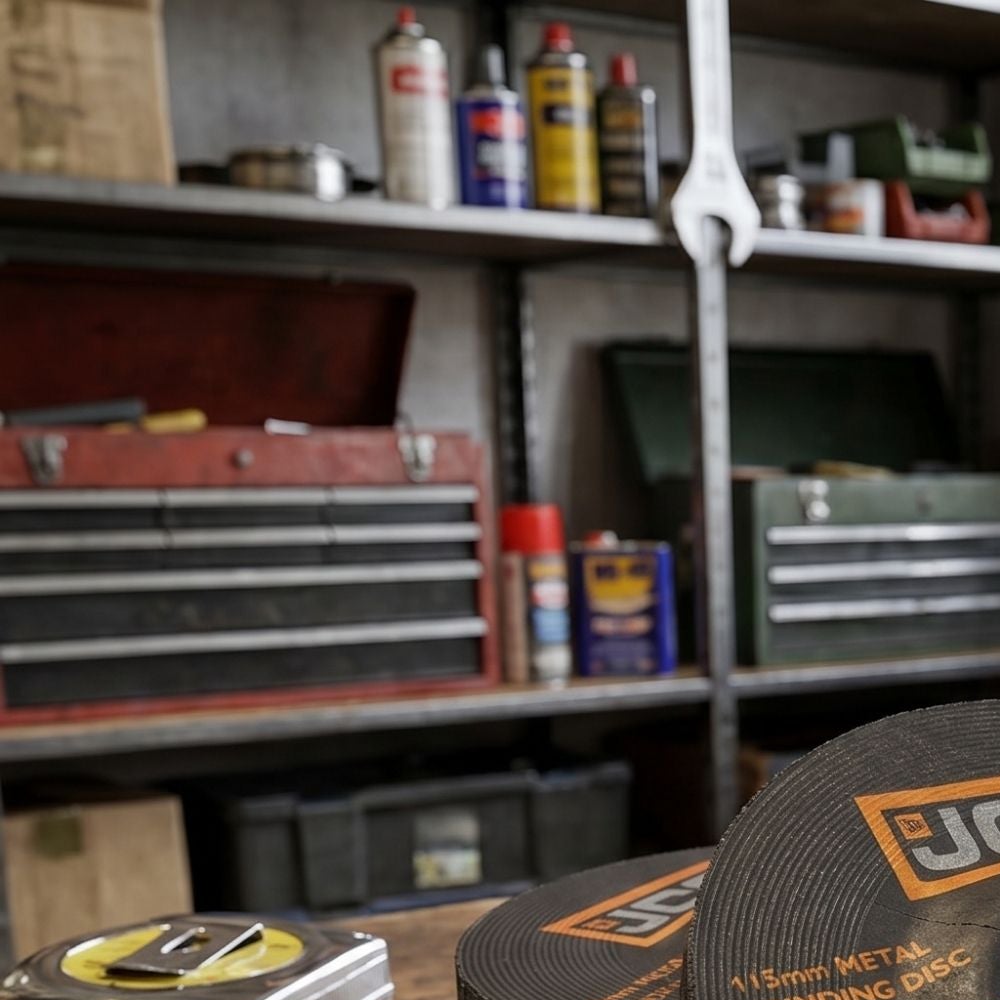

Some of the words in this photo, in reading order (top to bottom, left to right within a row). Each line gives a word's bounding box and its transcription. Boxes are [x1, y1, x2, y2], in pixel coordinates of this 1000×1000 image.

[731, 962, 831, 993] 115mm
[834, 941, 932, 976] METAL
[899, 948, 973, 993] DISC
